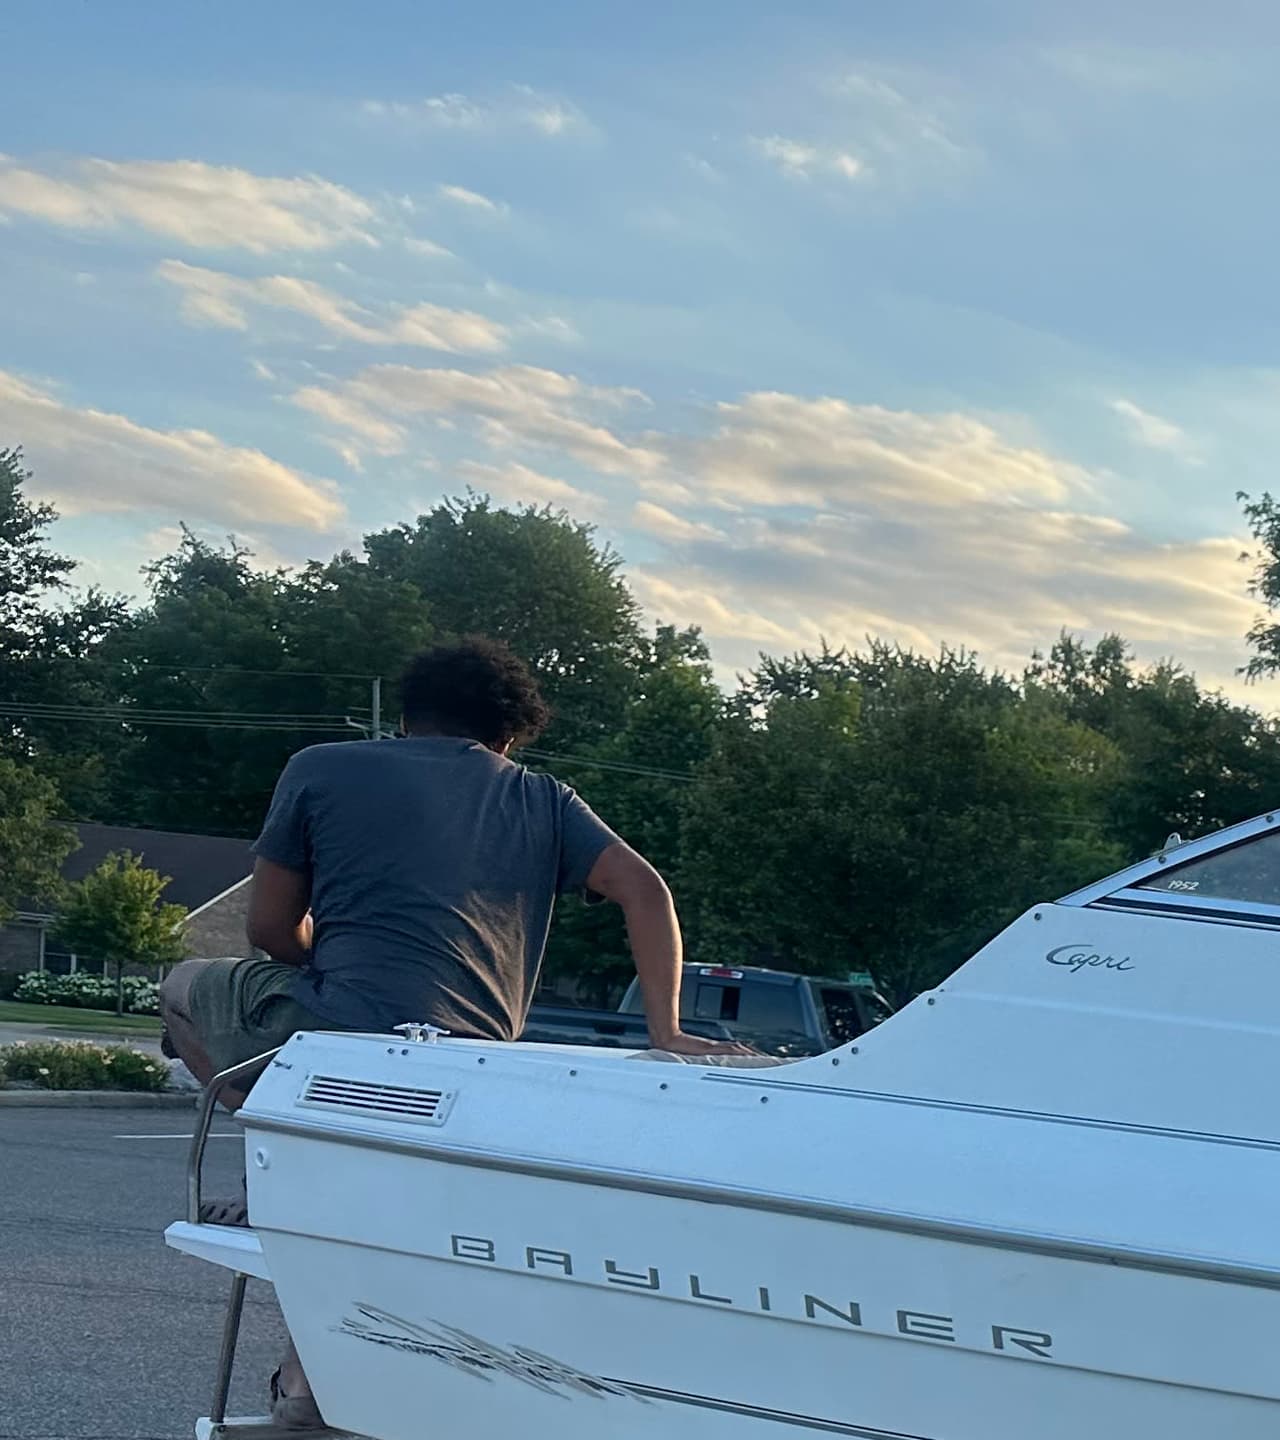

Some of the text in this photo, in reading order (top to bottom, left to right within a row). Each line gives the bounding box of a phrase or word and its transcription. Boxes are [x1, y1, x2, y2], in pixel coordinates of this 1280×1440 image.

[1168, 879, 1200, 891] 1952
[1045, 943, 1136, 974] Capri
[450, 1233, 1053, 1359] BAYLINER
